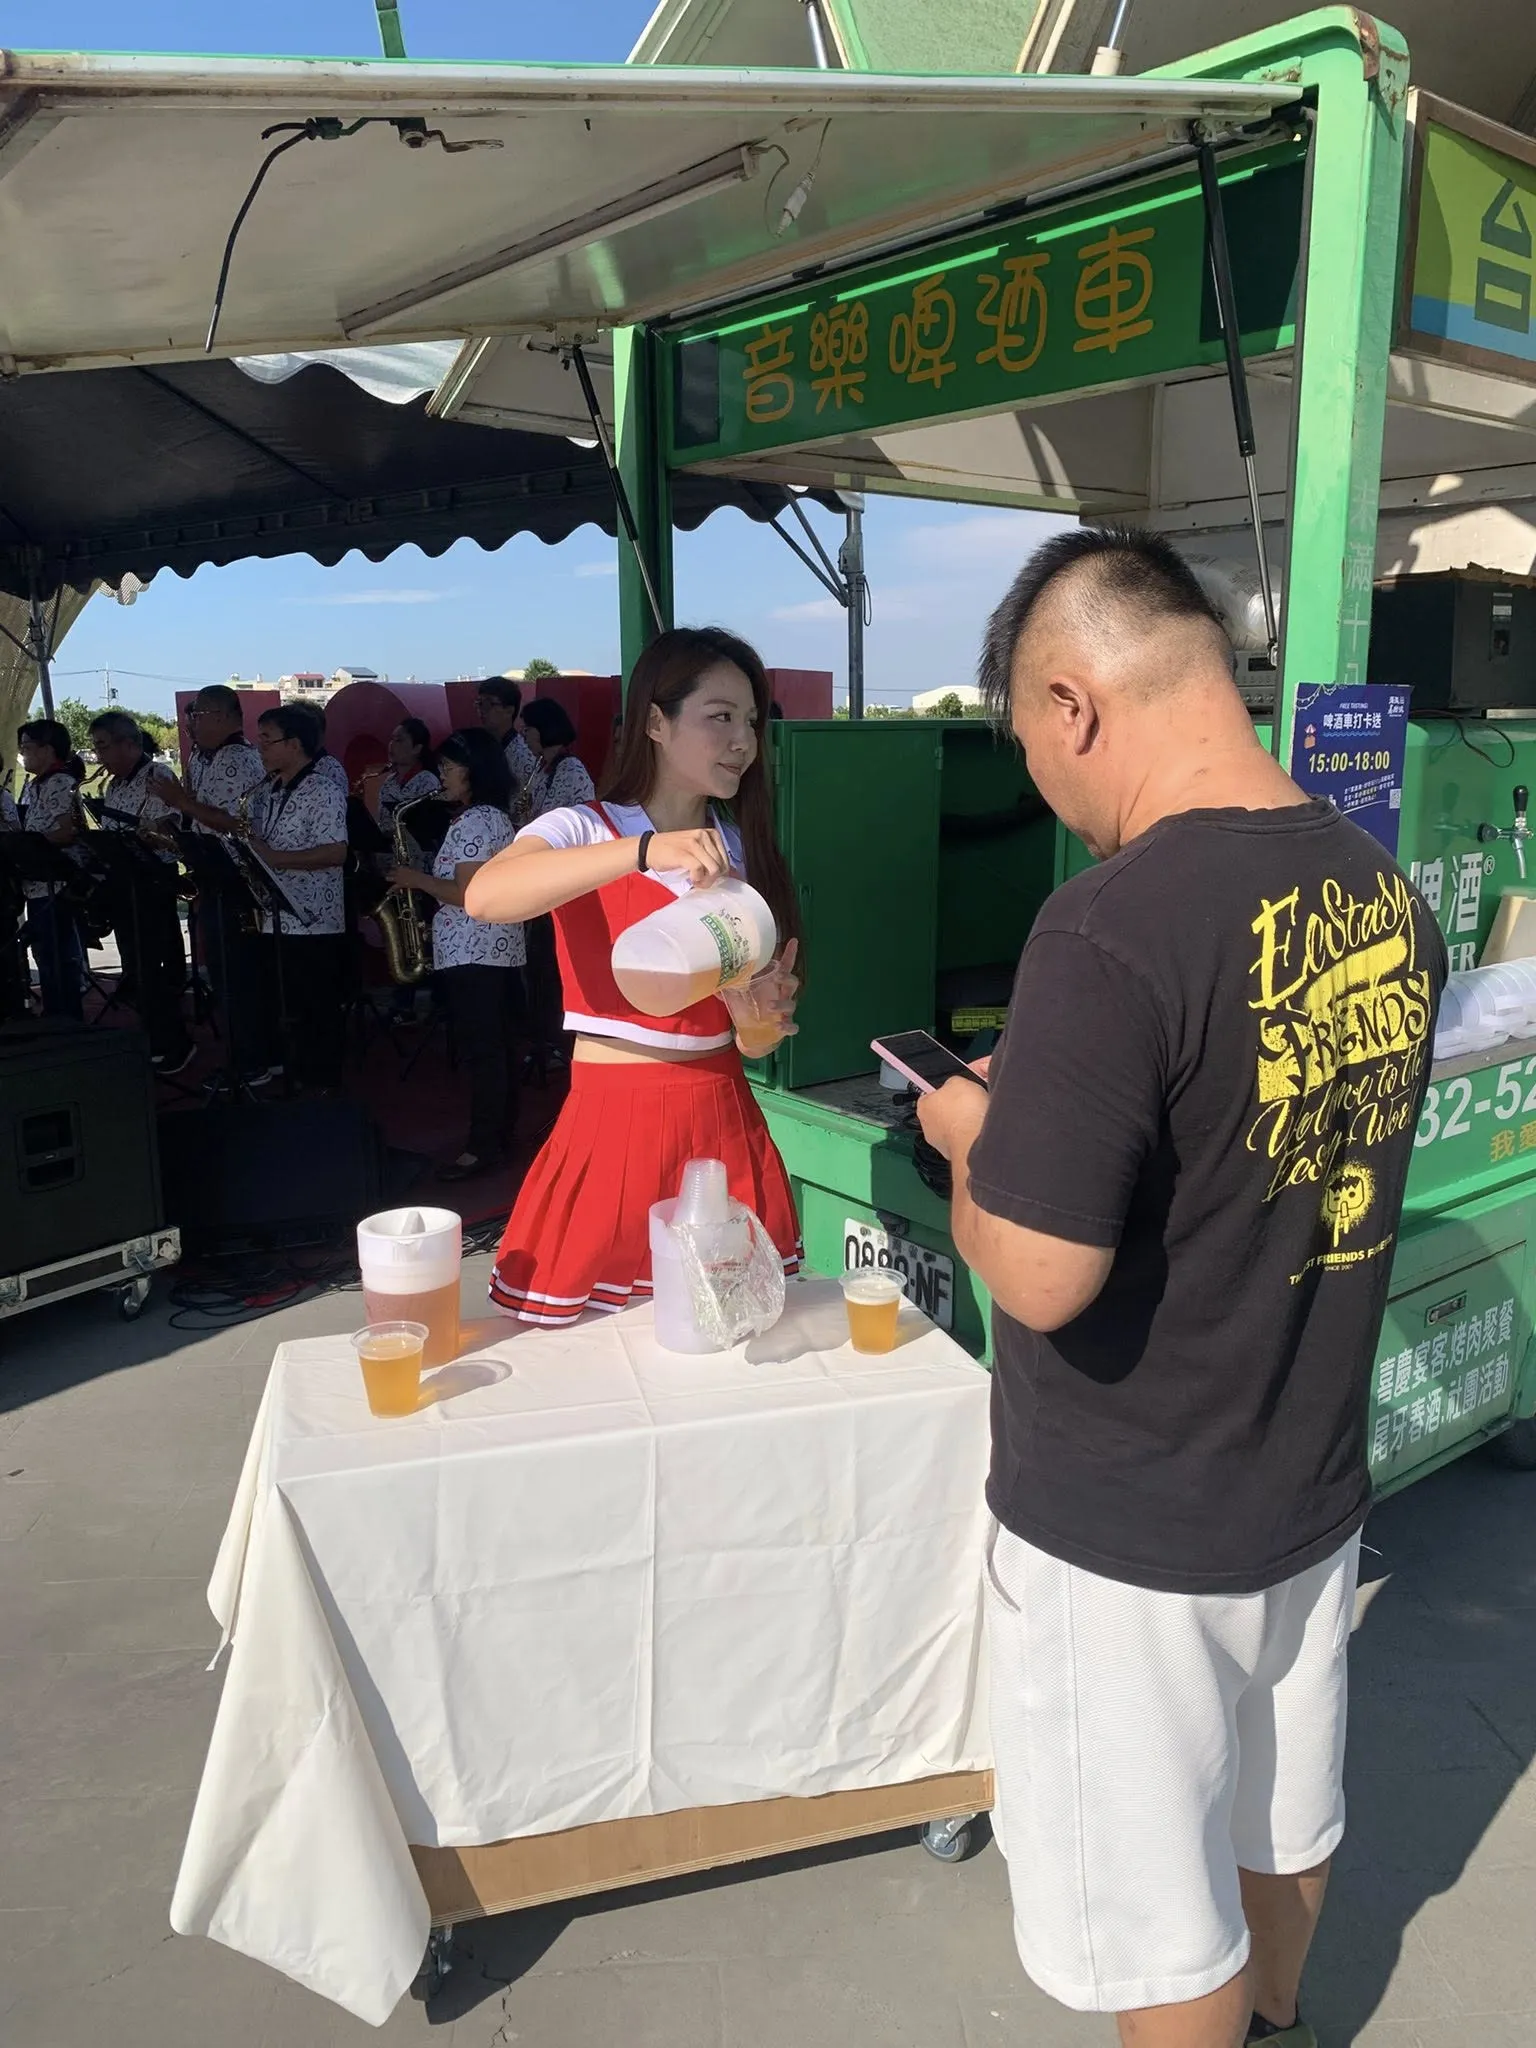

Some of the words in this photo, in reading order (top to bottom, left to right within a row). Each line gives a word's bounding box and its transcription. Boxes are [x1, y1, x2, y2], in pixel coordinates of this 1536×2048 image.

[742, 227, 1156, 424] 音樂啤酒車
[1323, 713, 1382, 730] 啤酒車打卡送
[1309, 751, 1390, 773] 15:00-18:00
[1248, 871, 1421, 1010] Ecstasy
[1317, 1249, 1365, 1266] FRIENDS
